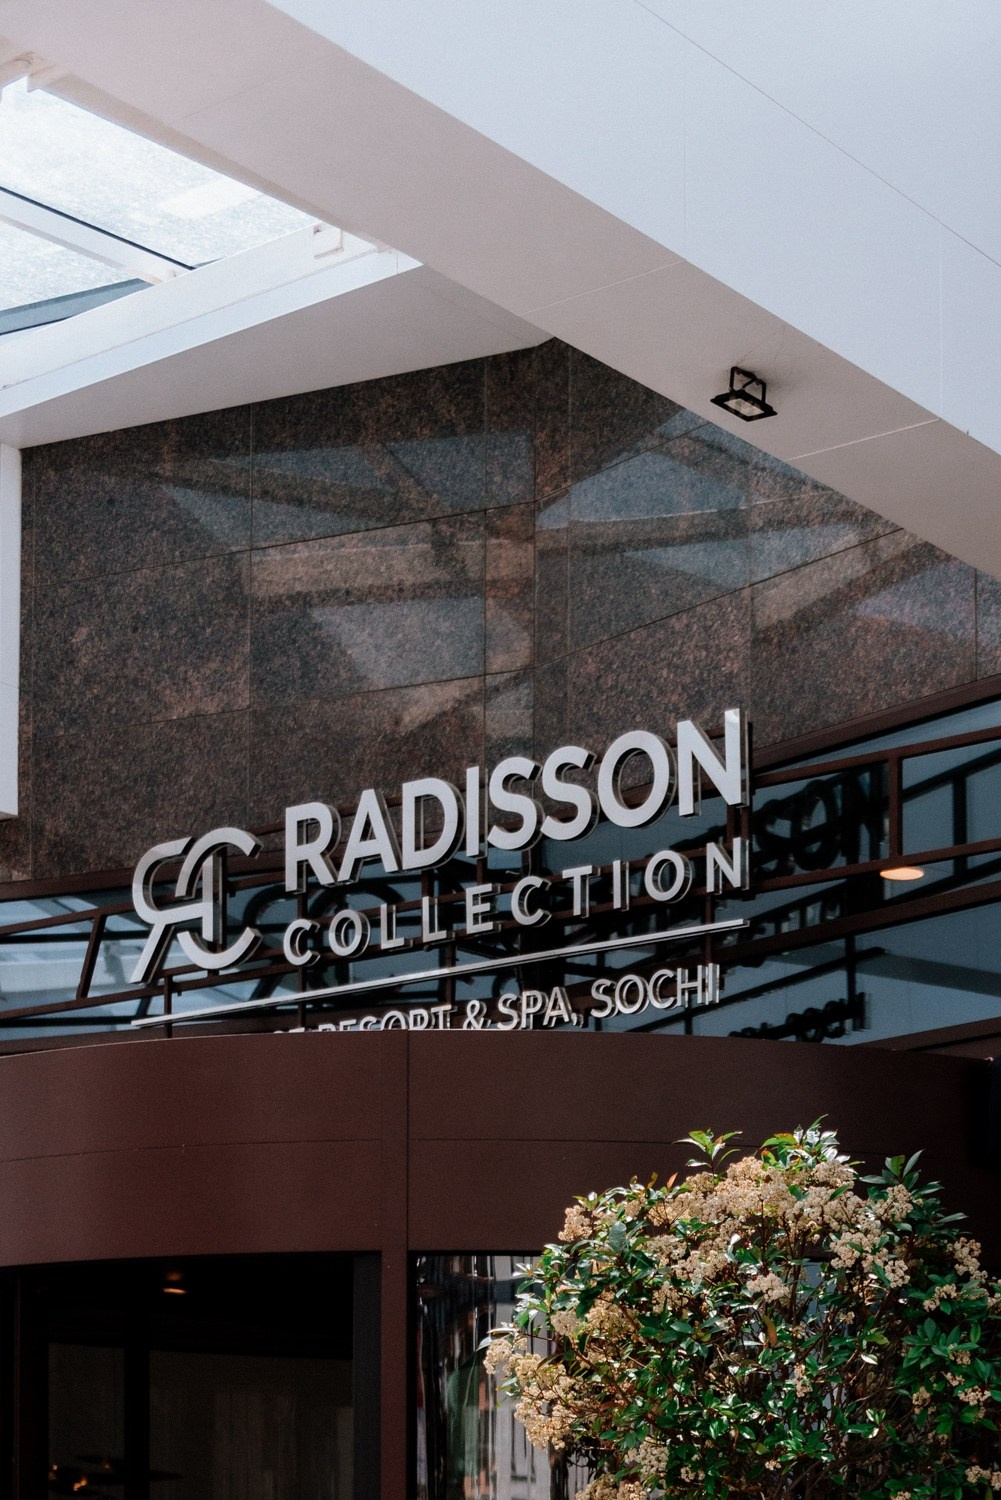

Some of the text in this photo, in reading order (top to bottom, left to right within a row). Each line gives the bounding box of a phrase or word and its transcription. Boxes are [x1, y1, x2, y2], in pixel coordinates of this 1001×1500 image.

[284, 707, 746, 894] RADISSON
[283, 836, 746, 968] COLLECTION
[496, 985, 580, 1031] SPA,
[590, 962, 721, 1019] SOCHI
